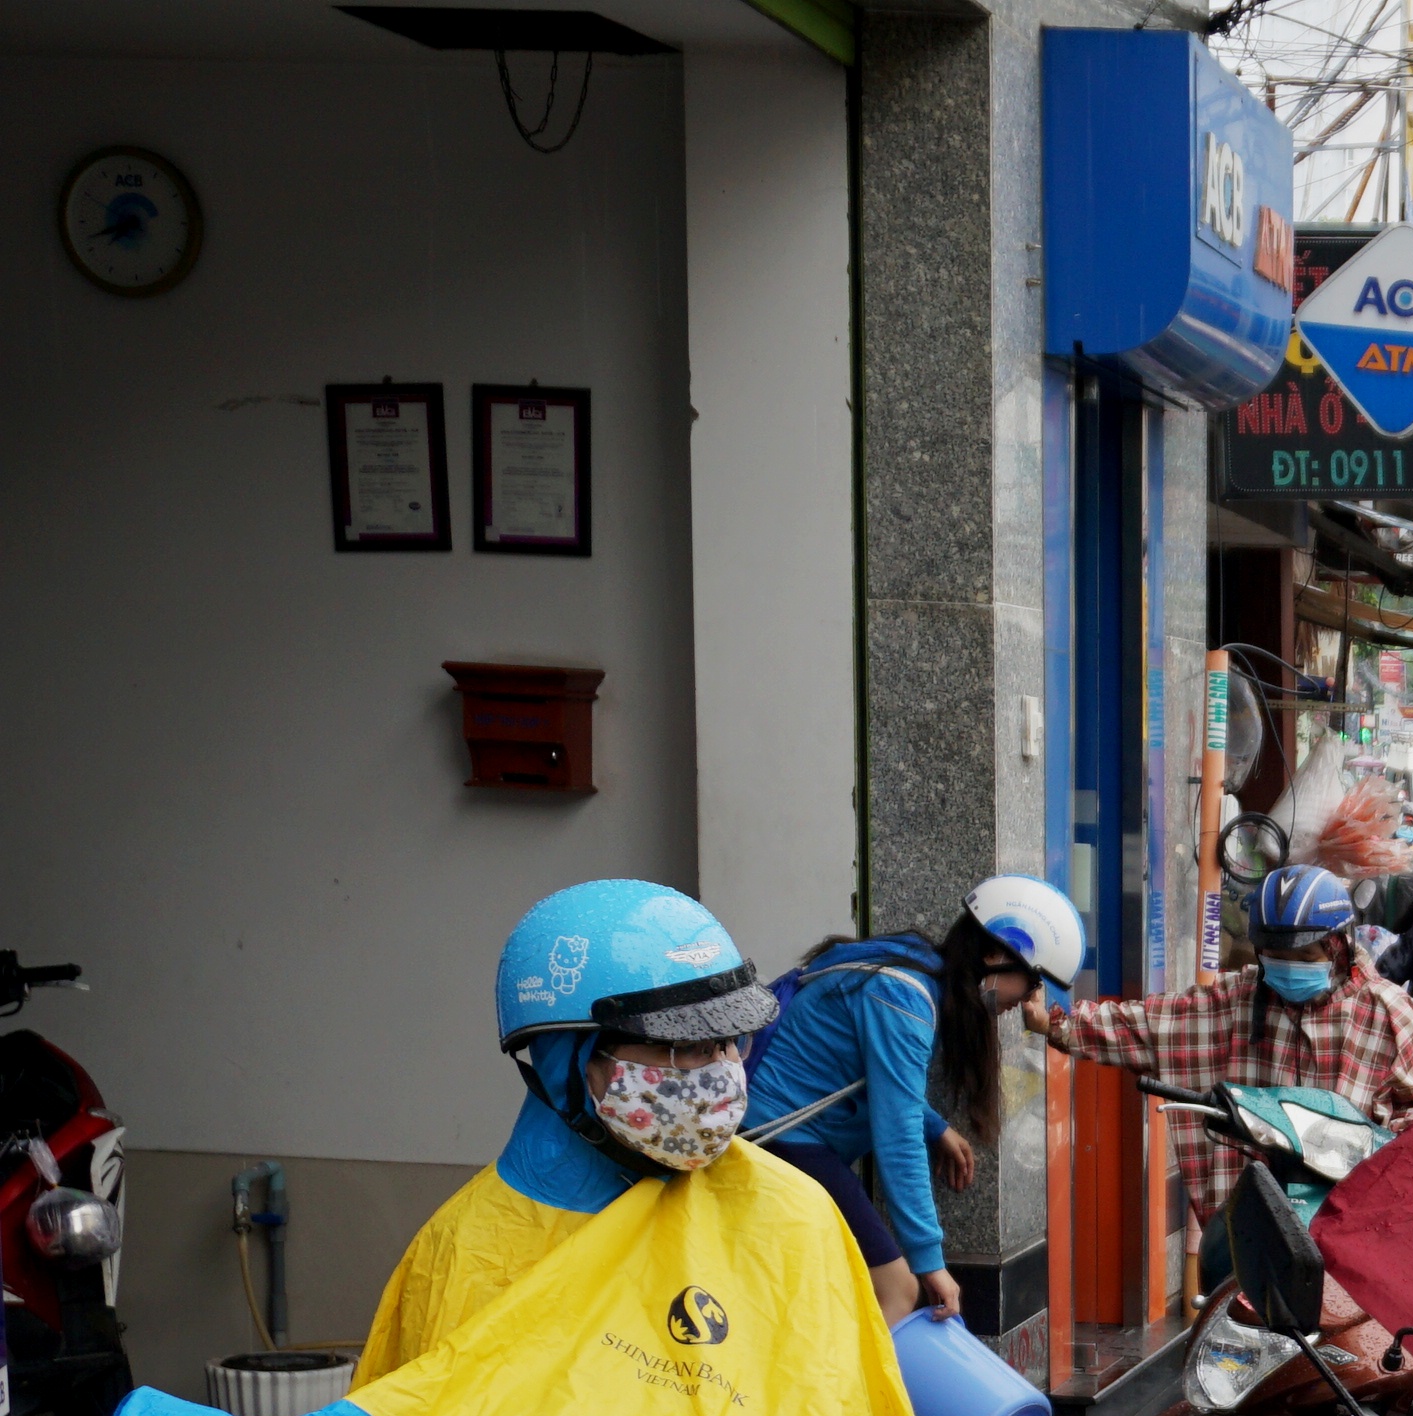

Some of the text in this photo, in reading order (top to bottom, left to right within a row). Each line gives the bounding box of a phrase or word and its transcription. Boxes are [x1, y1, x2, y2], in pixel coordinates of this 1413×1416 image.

[1201, 131, 1243, 247] ACB
[1236, 381, 1307, 435] NHÀ
[1272, 450, 1320, 486] ĐT:
[1331, 450, 1404, 486] 0911
[600, 1332, 696, 1378] SHINHAN
[636, 1368, 701, 1396] VIETNAM
